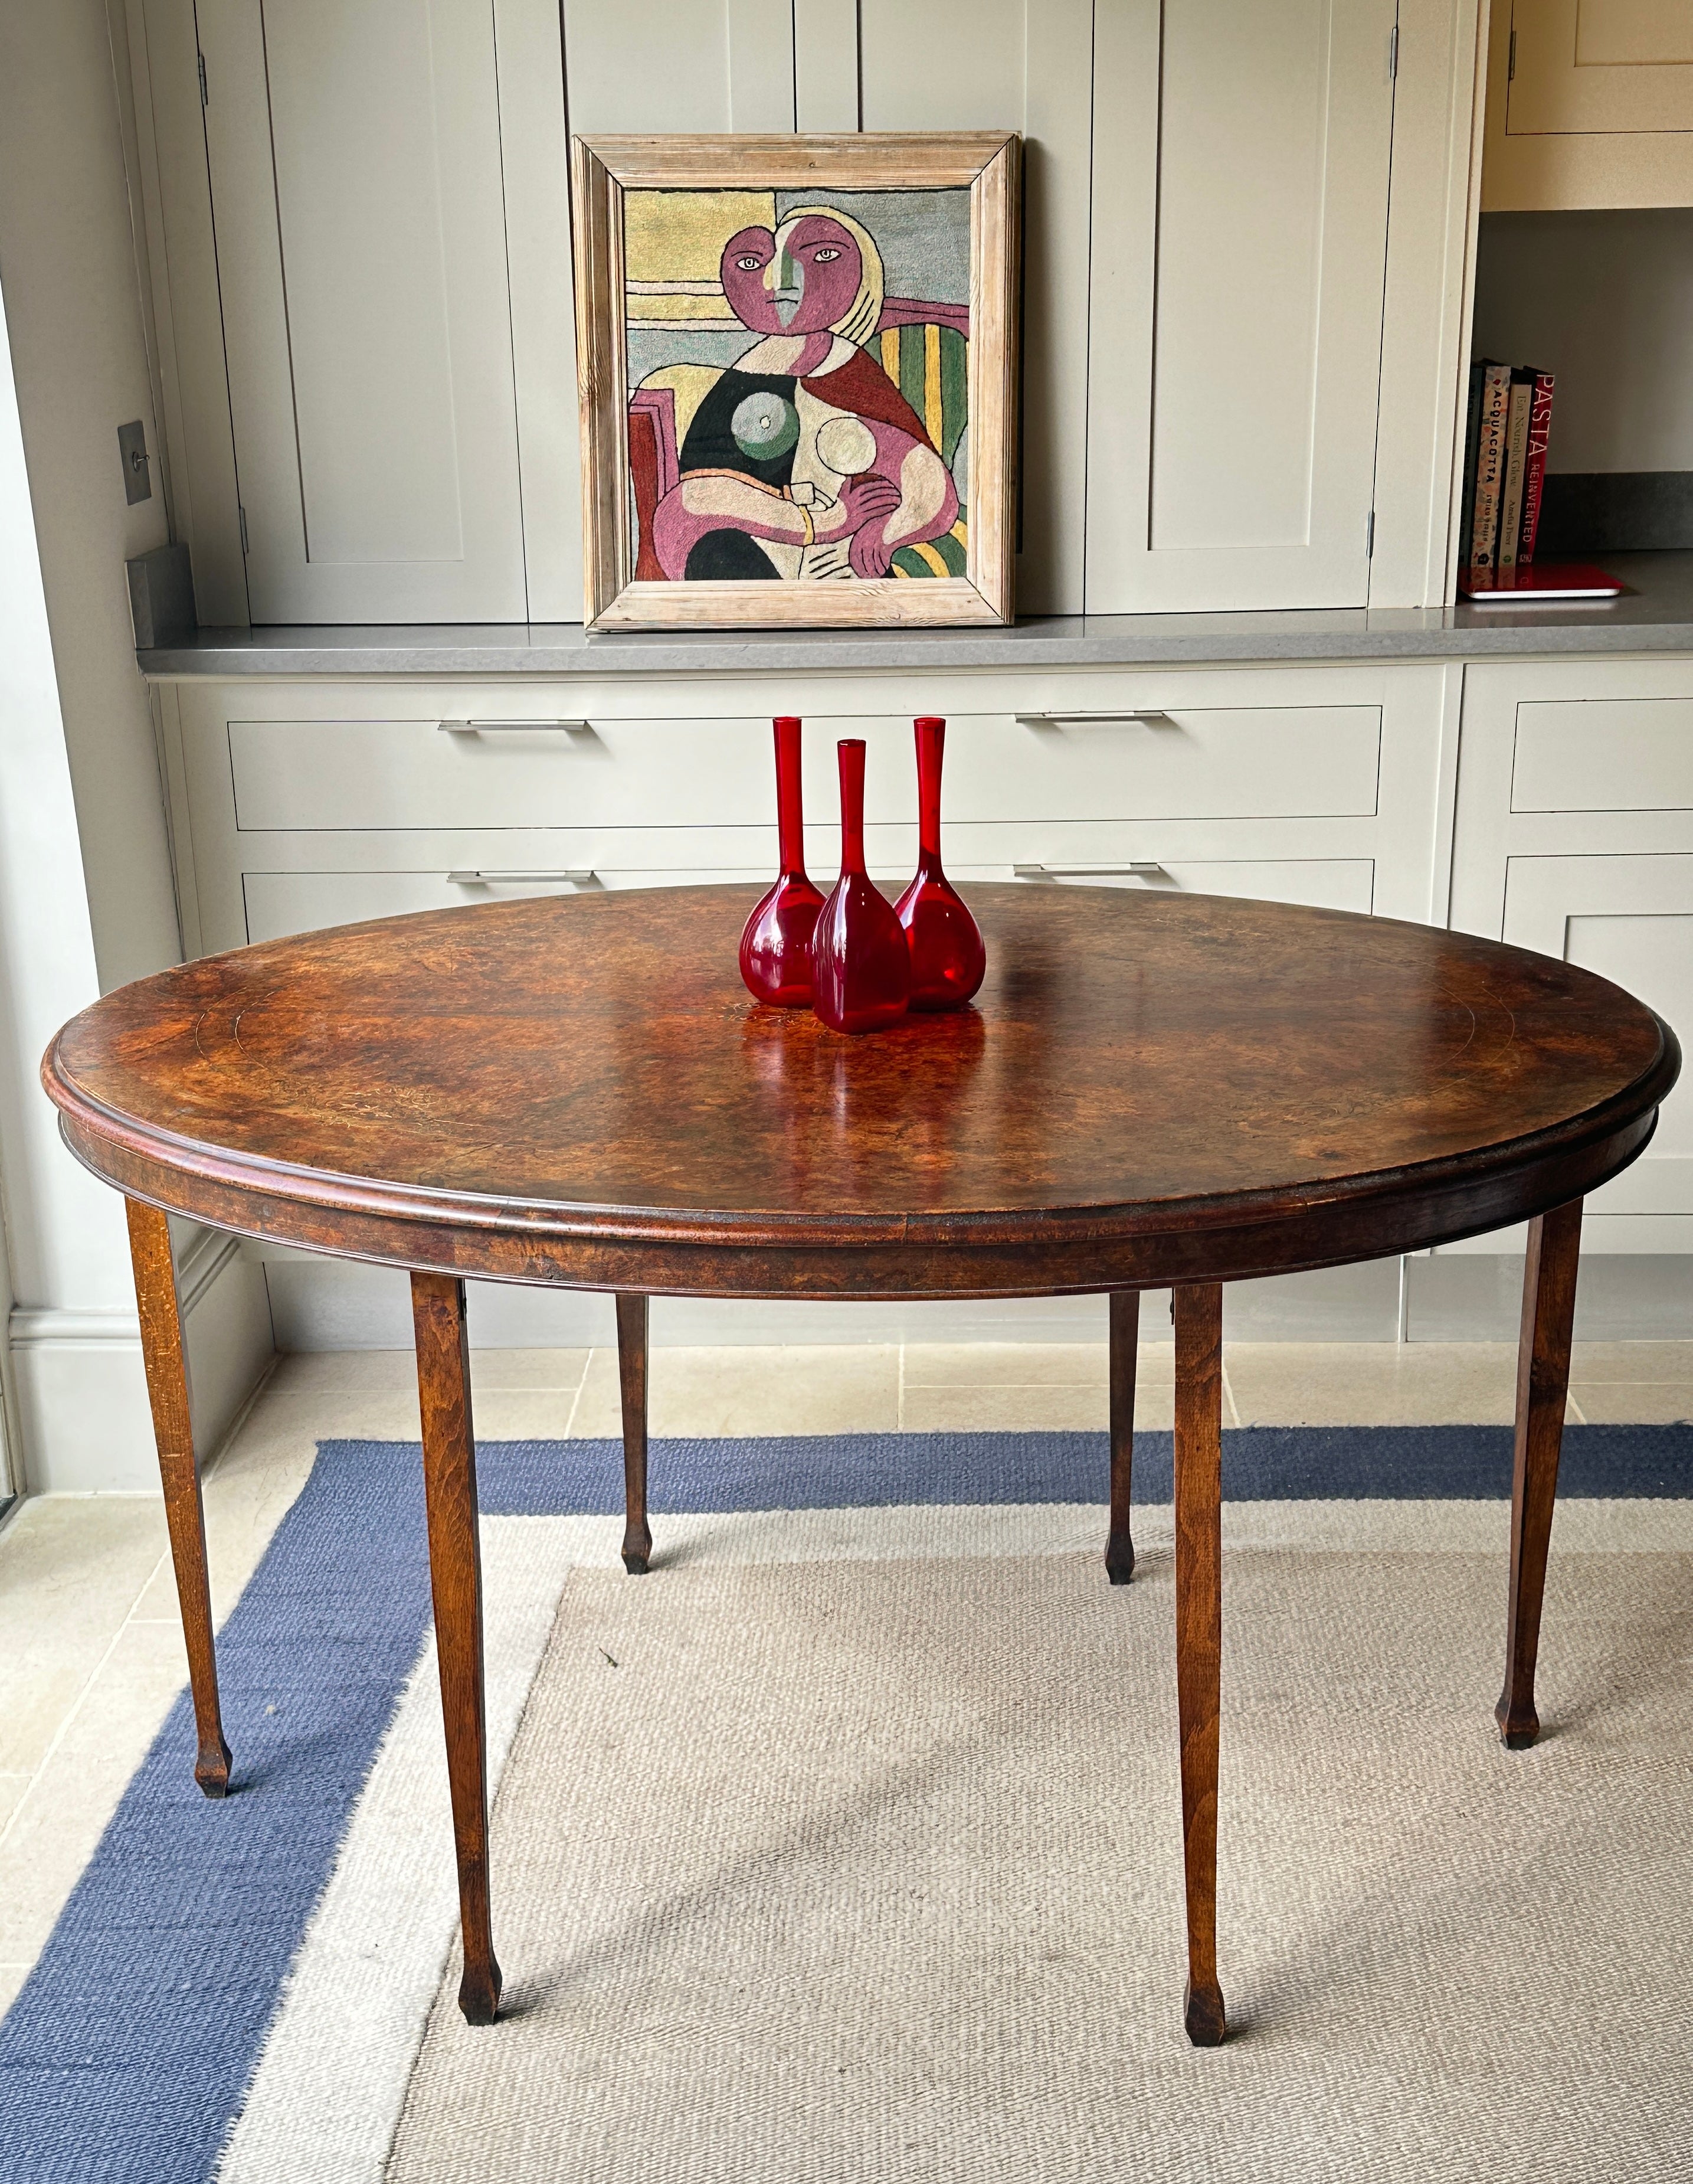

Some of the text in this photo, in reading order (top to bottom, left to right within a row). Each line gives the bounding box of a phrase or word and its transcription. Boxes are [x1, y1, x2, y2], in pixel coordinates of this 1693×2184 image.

[1486, 390, 1502, 483] ACQUACOTTA
[1528, 374, 1555, 456] PASTA
[1522, 464, 1540, 542] REINVENTED
